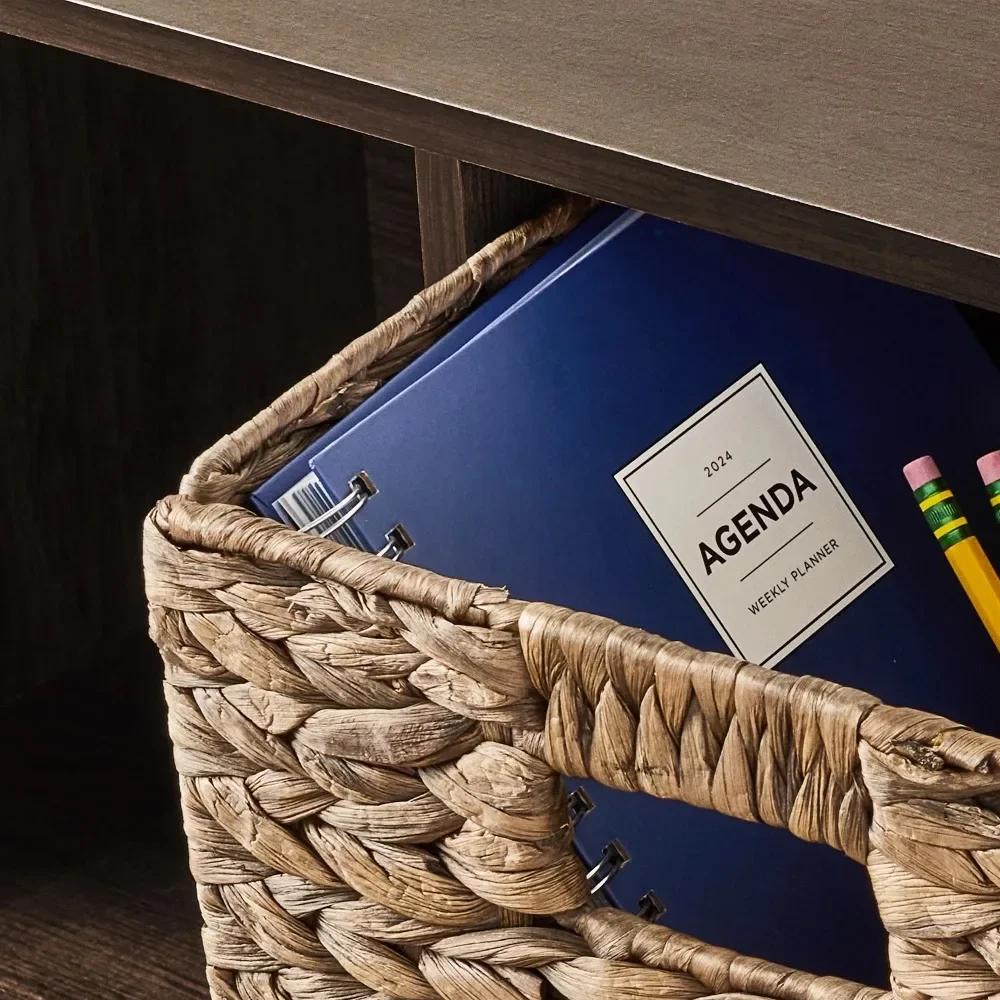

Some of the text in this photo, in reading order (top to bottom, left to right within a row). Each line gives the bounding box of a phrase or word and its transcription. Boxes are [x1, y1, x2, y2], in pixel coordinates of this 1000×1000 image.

[704, 450, 734, 478] 2024
[697, 468, 817, 576] AGENDA
[748, 538, 840, 616] WEEKLY PLANNER
